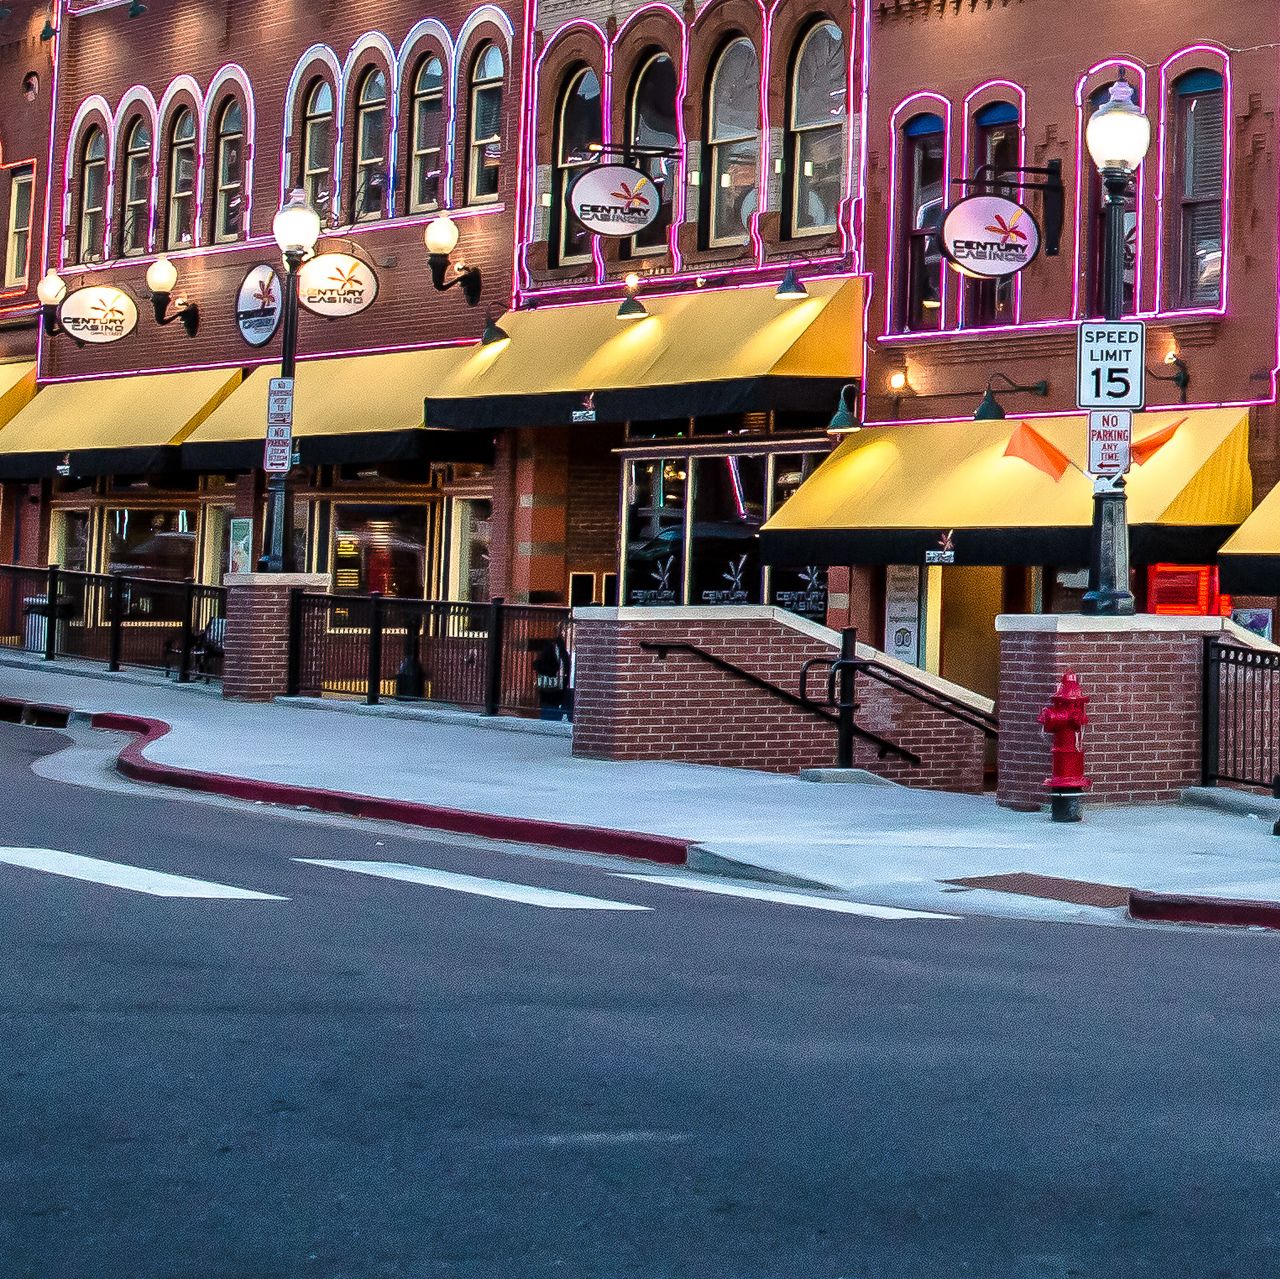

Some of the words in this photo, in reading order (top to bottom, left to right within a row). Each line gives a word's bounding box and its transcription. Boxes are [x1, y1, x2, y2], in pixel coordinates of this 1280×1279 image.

[580, 204, 650, 216] CENTURY
[953, 240, 1028, 252] CENTURY
[953, 249, 1027, 262] CASINOS
[300, 288, 364, 296] ENTURY
[63, 317, 125, 325] CENTURY
[1085, 331, 1139, 343] SPEED
[1090, 350, 1132, 361] LIMIT
[1091, 368, 1131, 398] 15
[1102, 415, 1118, 427] NO
[1091, 430, 1128, 441] PARKING
[1101, 443, 1118, 451] ANY
[1101, 453, 1120, 461] TIME
